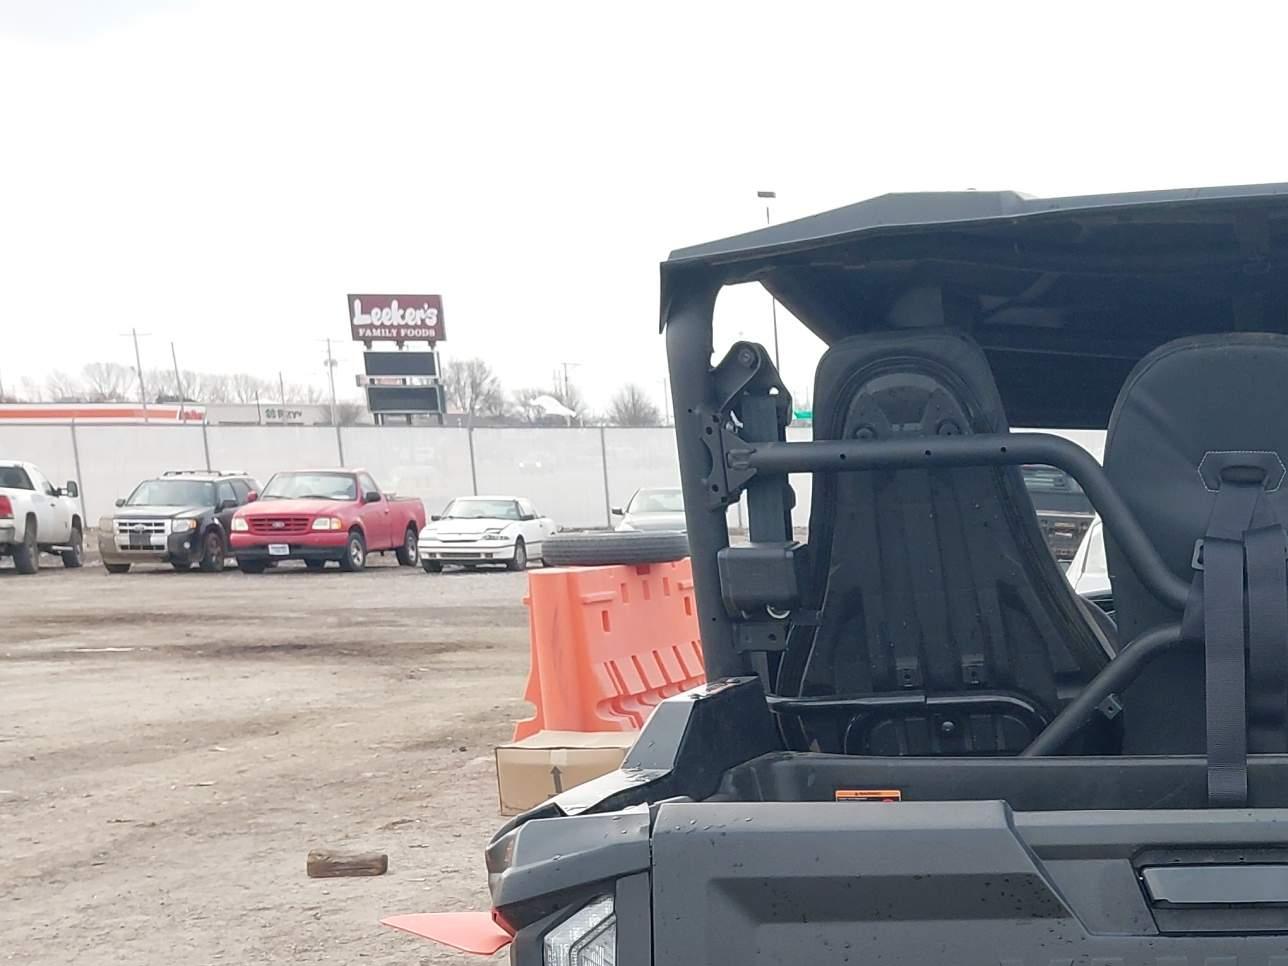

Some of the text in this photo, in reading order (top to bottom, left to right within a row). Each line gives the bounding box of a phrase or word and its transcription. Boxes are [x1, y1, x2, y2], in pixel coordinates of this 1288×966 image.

[353, 299, 438, 326] Leeker's
[358, 328, 436, 337] FAMILY FOODS
